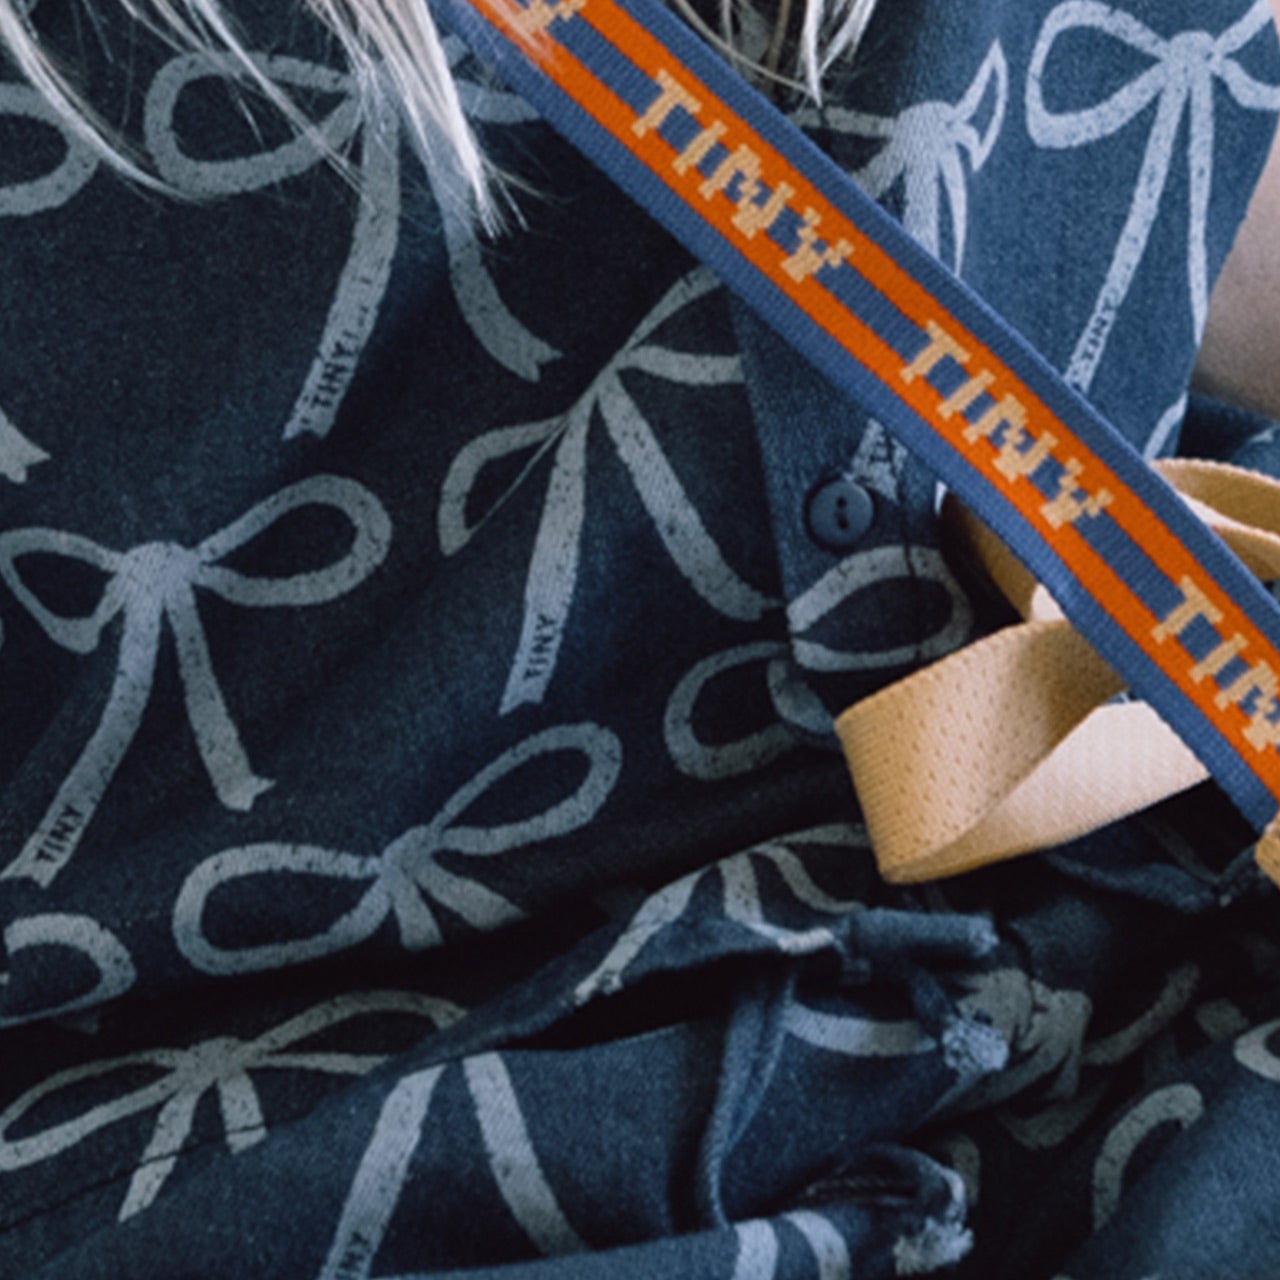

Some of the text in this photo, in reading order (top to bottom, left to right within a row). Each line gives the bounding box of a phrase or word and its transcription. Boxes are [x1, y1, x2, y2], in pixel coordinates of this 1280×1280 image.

[630, 69, 855, 283] TINY
[310, 340, 356, 410] TINY
[900, 320, 1113, 531] TINY
[521, 613, 559, 682] TINY
[35, 803, 84, 863] TINY
